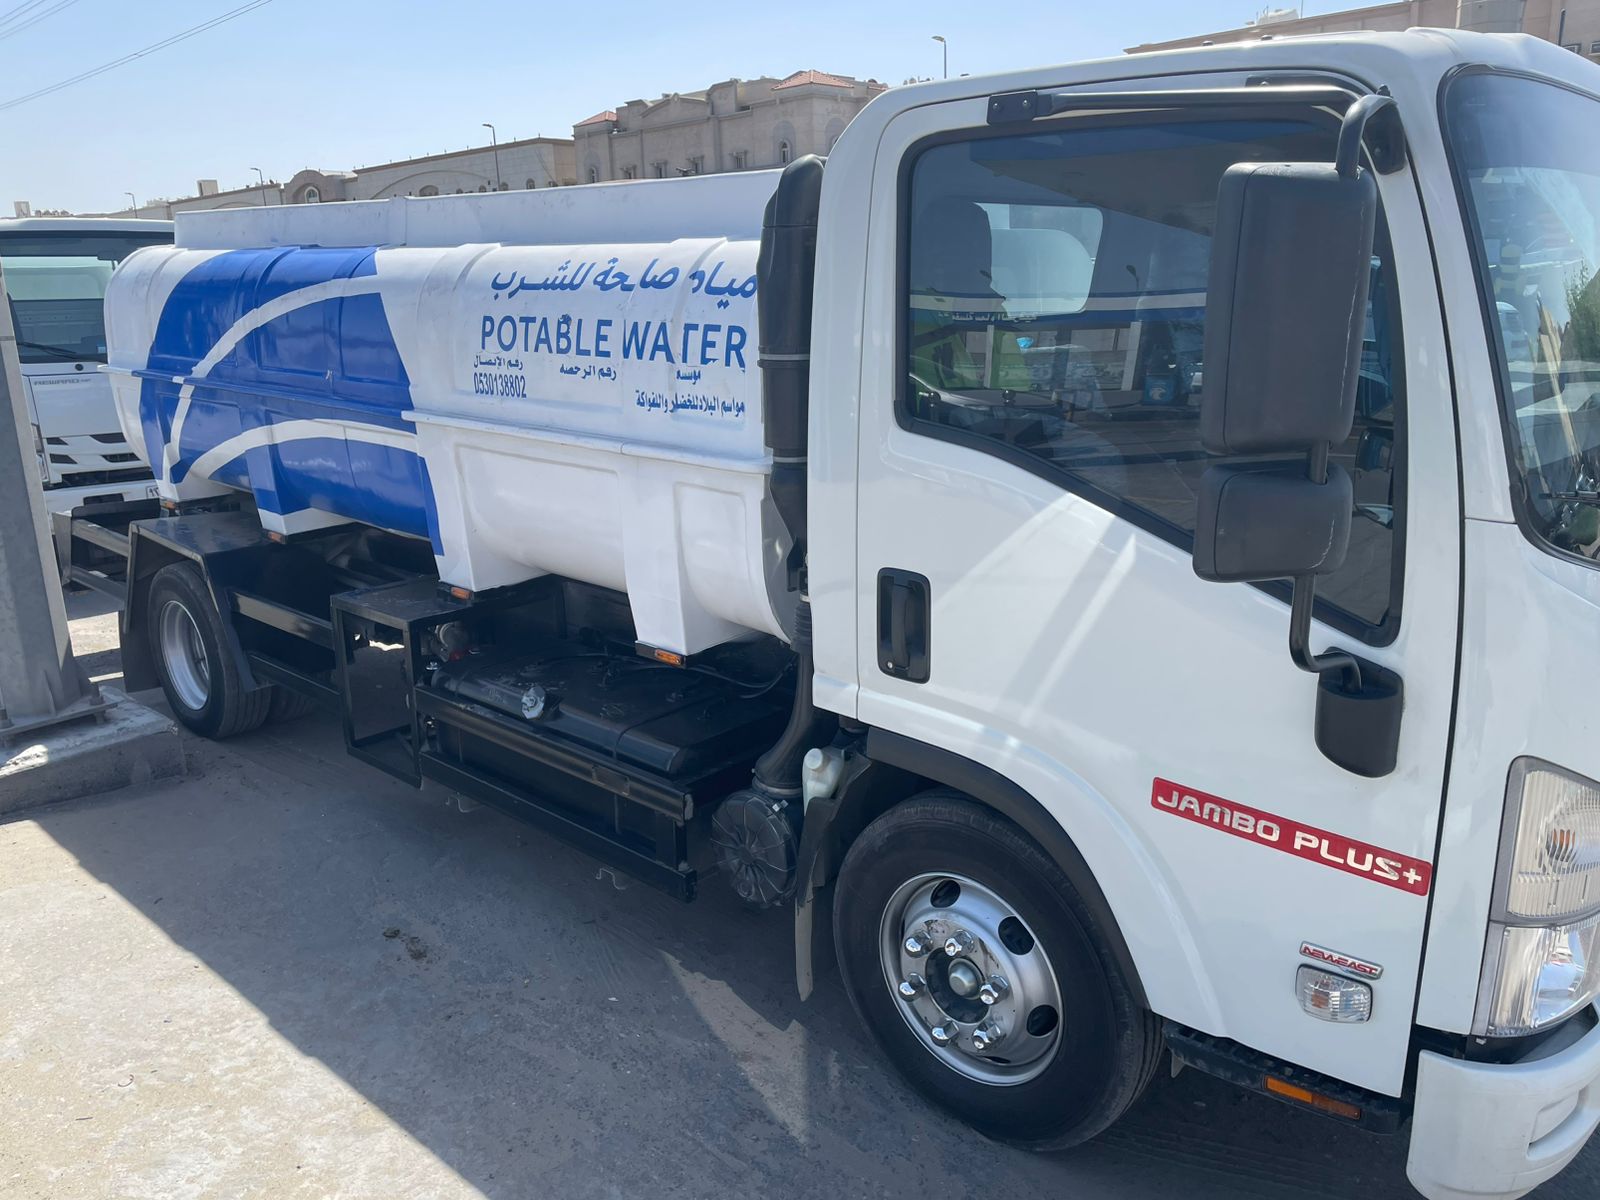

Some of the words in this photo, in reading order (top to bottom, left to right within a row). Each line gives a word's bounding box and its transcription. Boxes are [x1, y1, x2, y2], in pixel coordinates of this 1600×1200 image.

[491, 260, 597, 300] للشرب
[593, 257, 679, 292] صاحة
[481, 314, 613, 358] POTABLE
[622, 320, 747, 370] WATER
[473, 372, 527, 398] 0530138802
[1157, 791, 1280, 842] JAMBO
